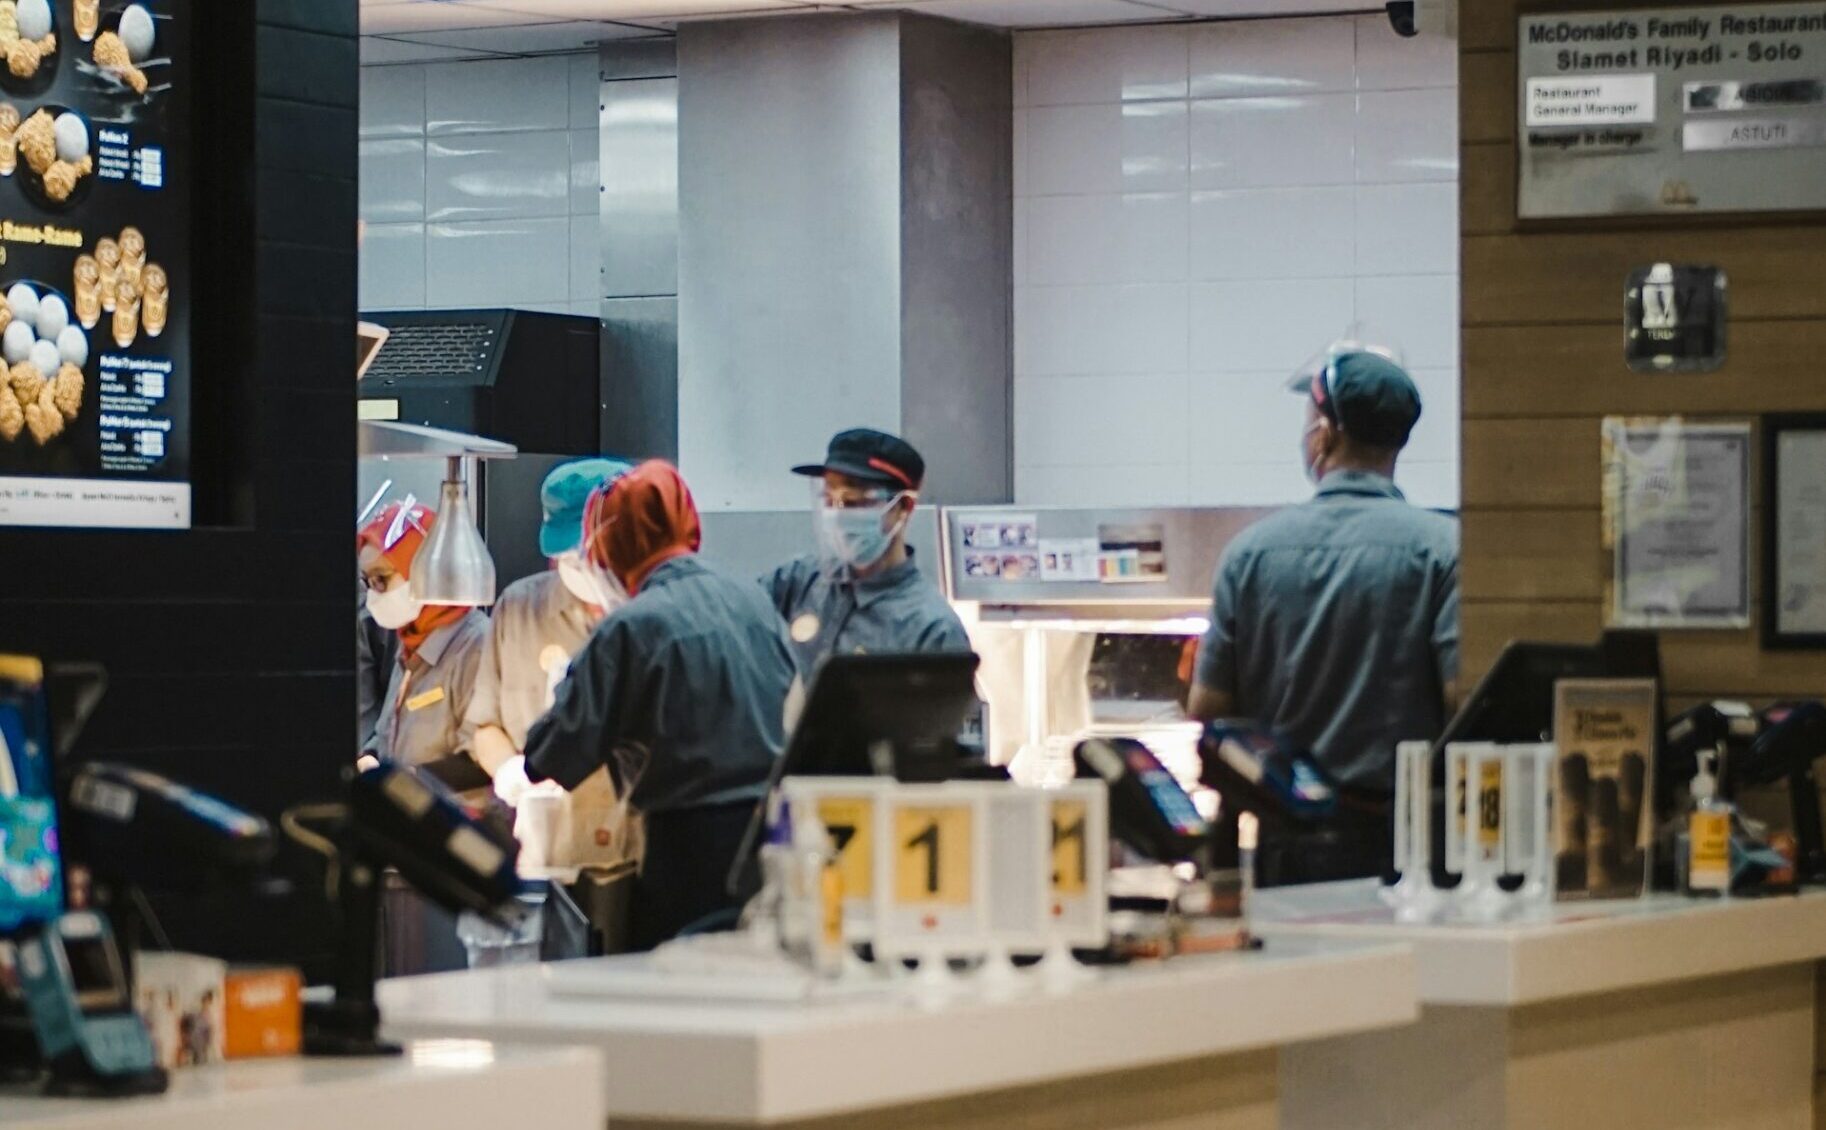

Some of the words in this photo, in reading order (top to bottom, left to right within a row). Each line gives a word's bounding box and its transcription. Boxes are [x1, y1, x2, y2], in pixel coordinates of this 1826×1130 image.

[1529, 21, 1638, 43] McDonald's
[1648, 17, 1710, 40] Family
[1556, 49, 1638, 71] Slamet
[1646, 43, 1721, 70] Riyadi
[1747, 41, 1802, 63] Solo
[1534, 87, 1600, 99] Restaurant
[1534, 104, 1581, 117] General
[1585, 102, 1638, 115] Manager
[1729, 125, 1788, 143] ASTUTI
[906, 817, 939, 893] 1
